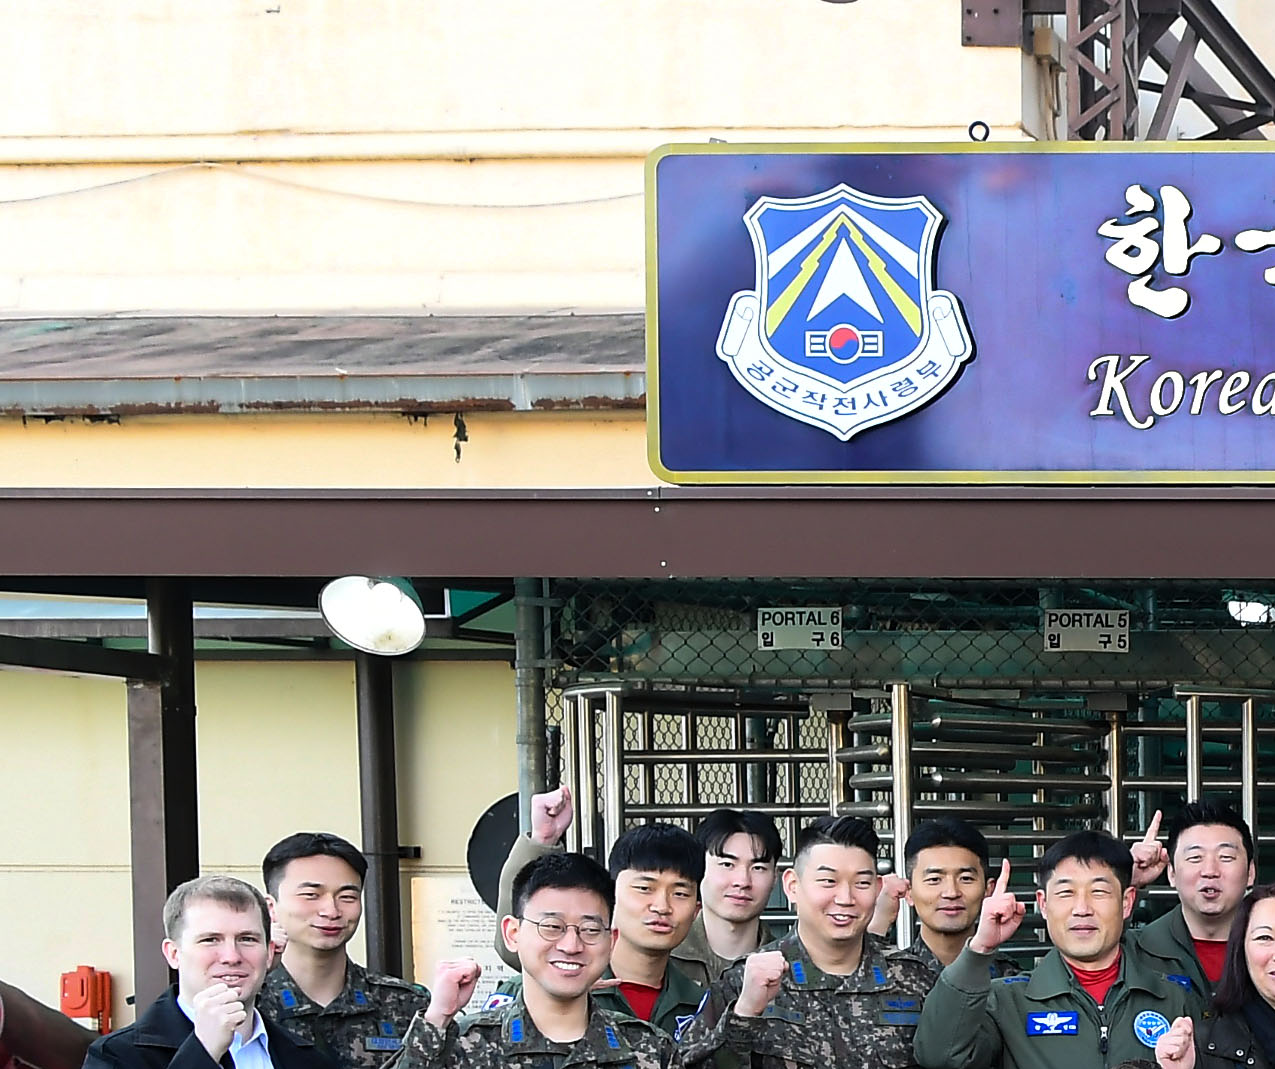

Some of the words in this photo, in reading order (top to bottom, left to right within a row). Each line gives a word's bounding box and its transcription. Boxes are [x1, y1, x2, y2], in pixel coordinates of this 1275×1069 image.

[746, 359, 943, 416] 공군작전사령부
[761, 610, 828, 627] PORTAL
[830, 610, 840, 626] 6
[1048, 612, 1115, 629] PORTAL
[1117, 612, 1128, 629] 5
[830, 631, 840, 647] 6
[1117, 633, 1127, 650] 5
